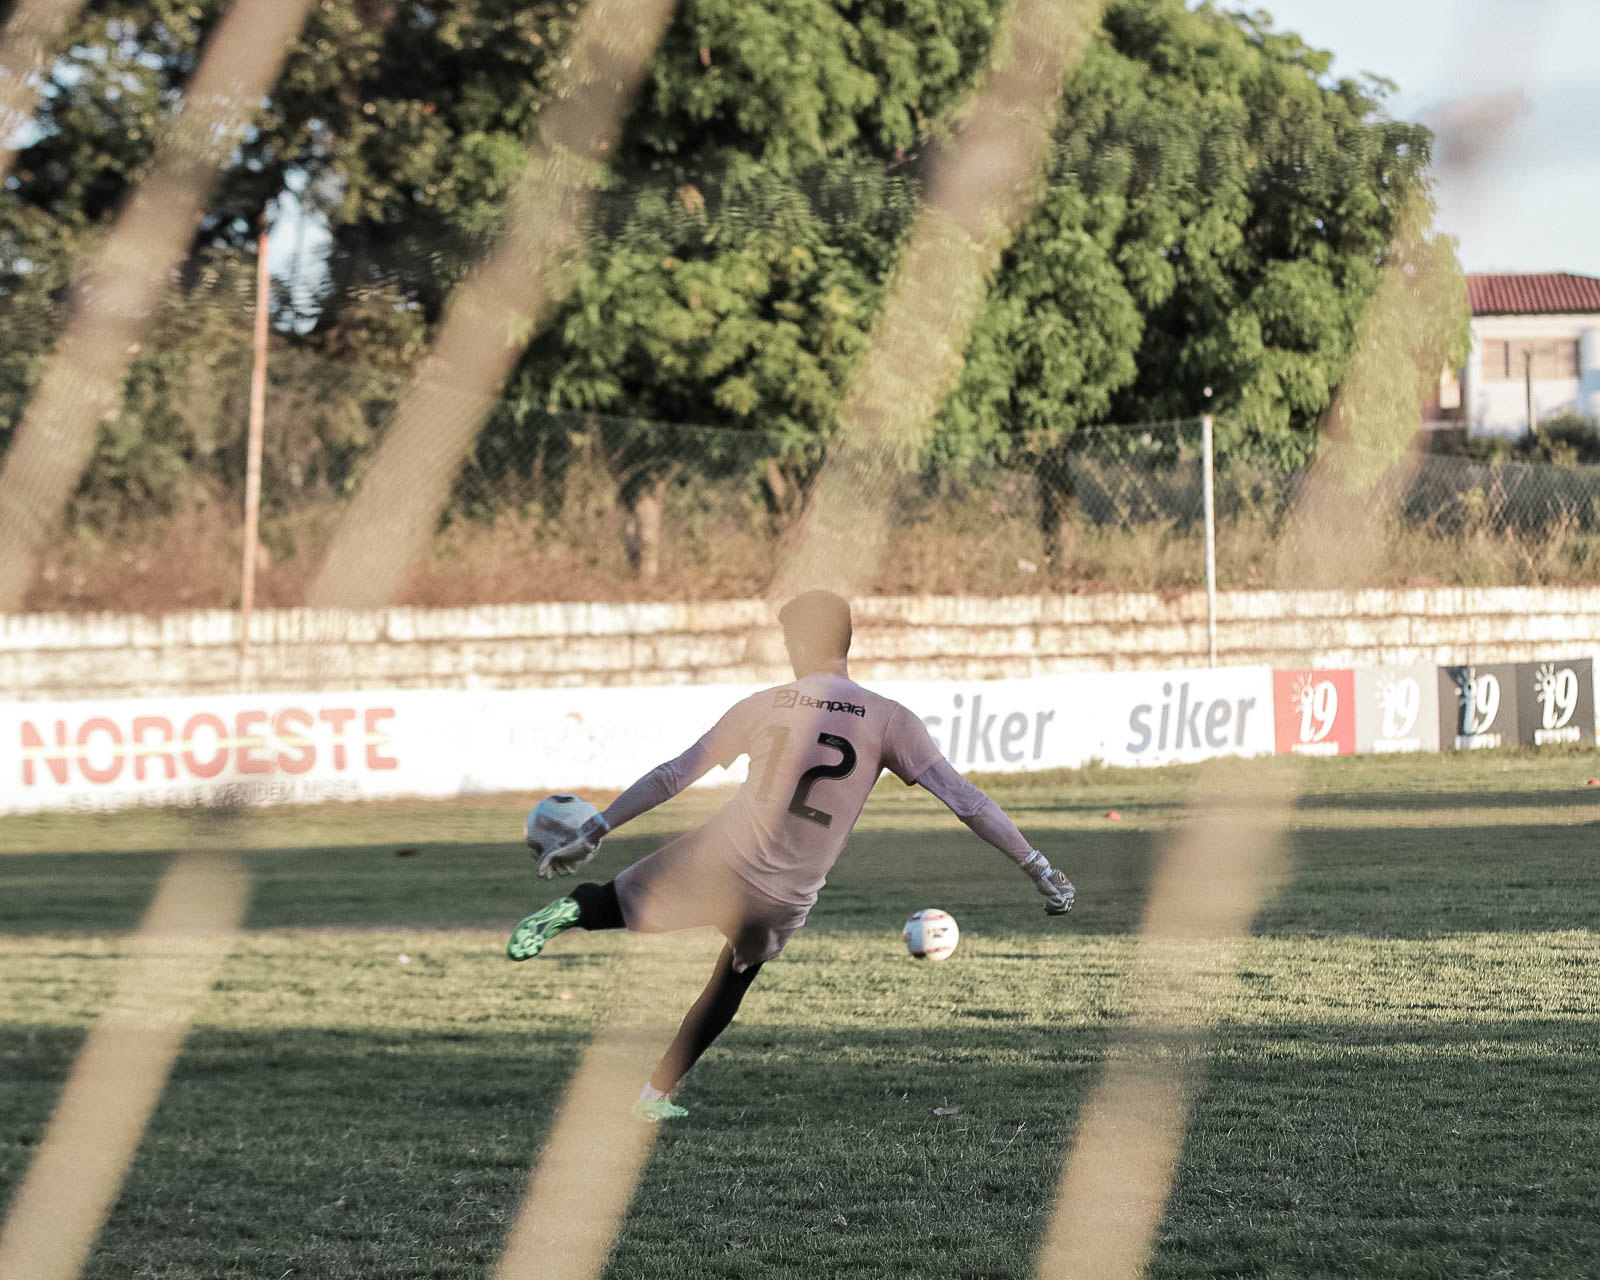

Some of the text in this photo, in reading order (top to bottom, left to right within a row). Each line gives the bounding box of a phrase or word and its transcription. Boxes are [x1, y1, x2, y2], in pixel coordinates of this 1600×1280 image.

[20, 707, 398, 785] NOROESTE
[1126, 682, 1256, 754] siker
[751, 726, 857, 828] 12
